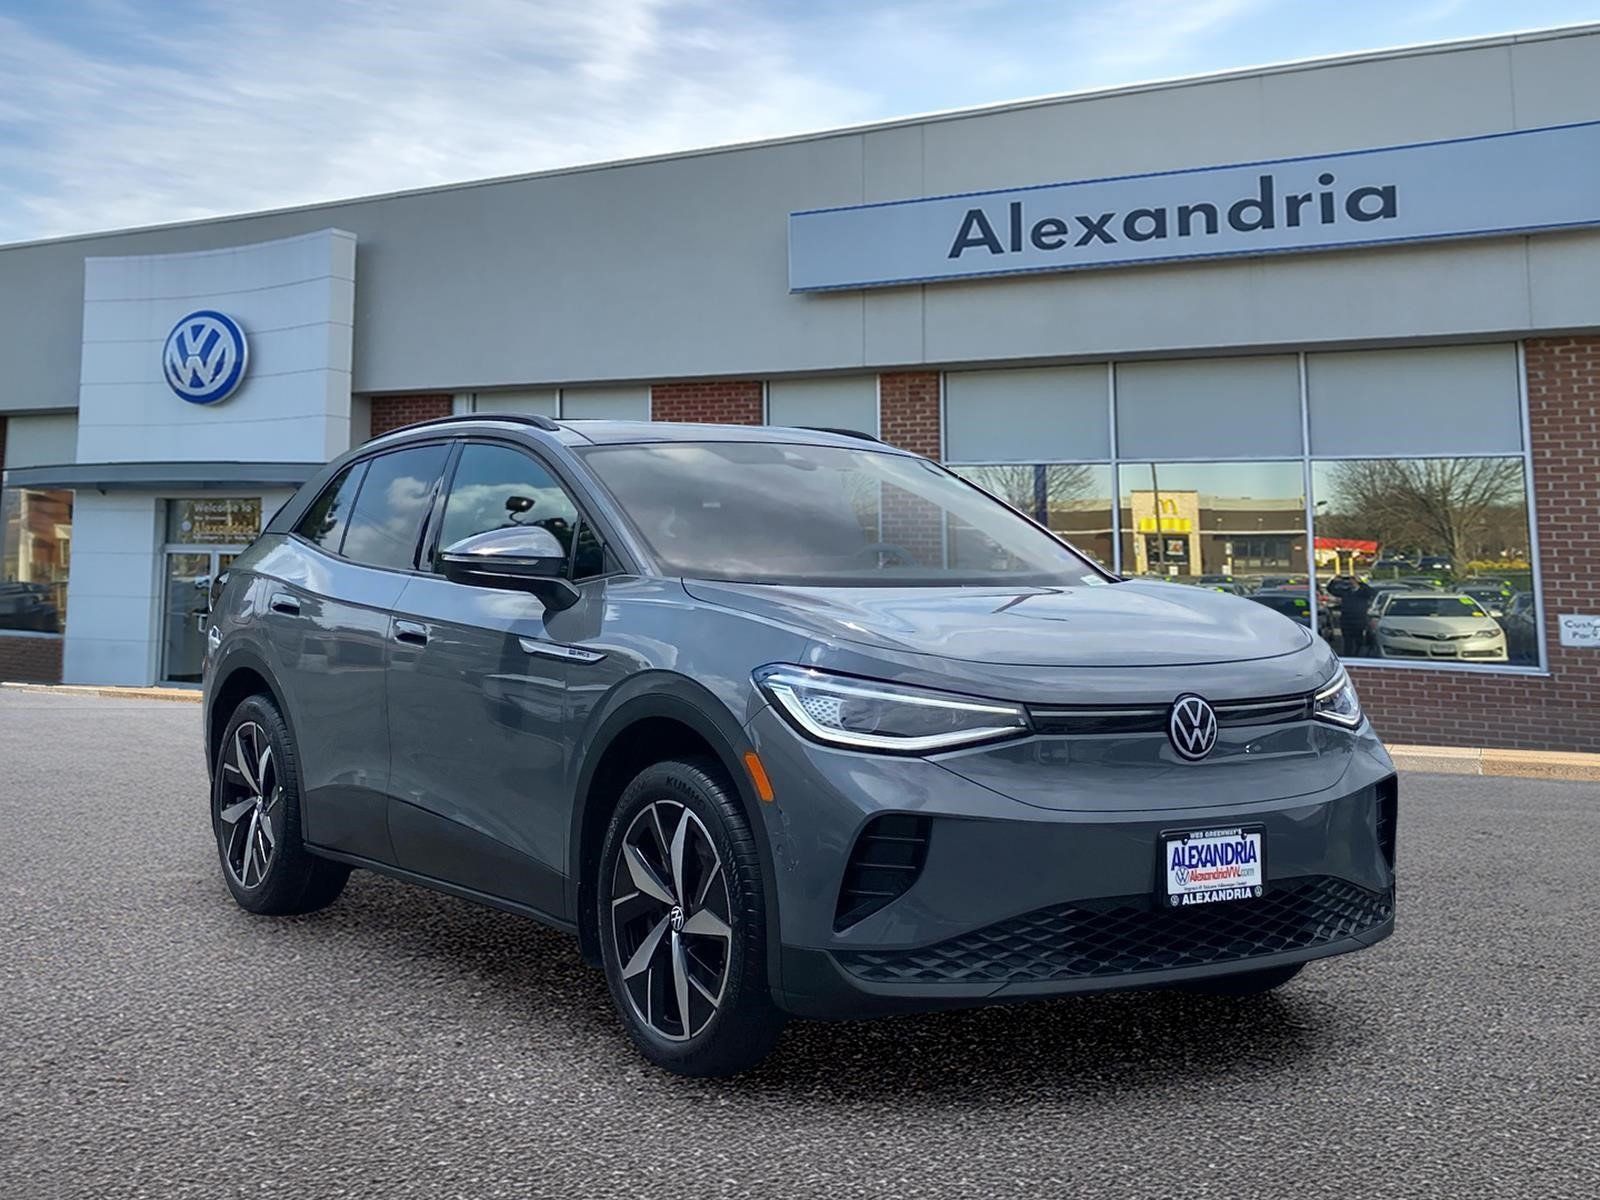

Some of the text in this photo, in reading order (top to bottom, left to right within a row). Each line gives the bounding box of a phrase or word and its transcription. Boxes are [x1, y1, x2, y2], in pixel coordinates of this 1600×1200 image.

[947, 172, 1398, 260] Alexandria
[1171, 840, 1257, 870] ALEXANDRIA
[1182, 887, 1252, 905] ALEXANDRIA
